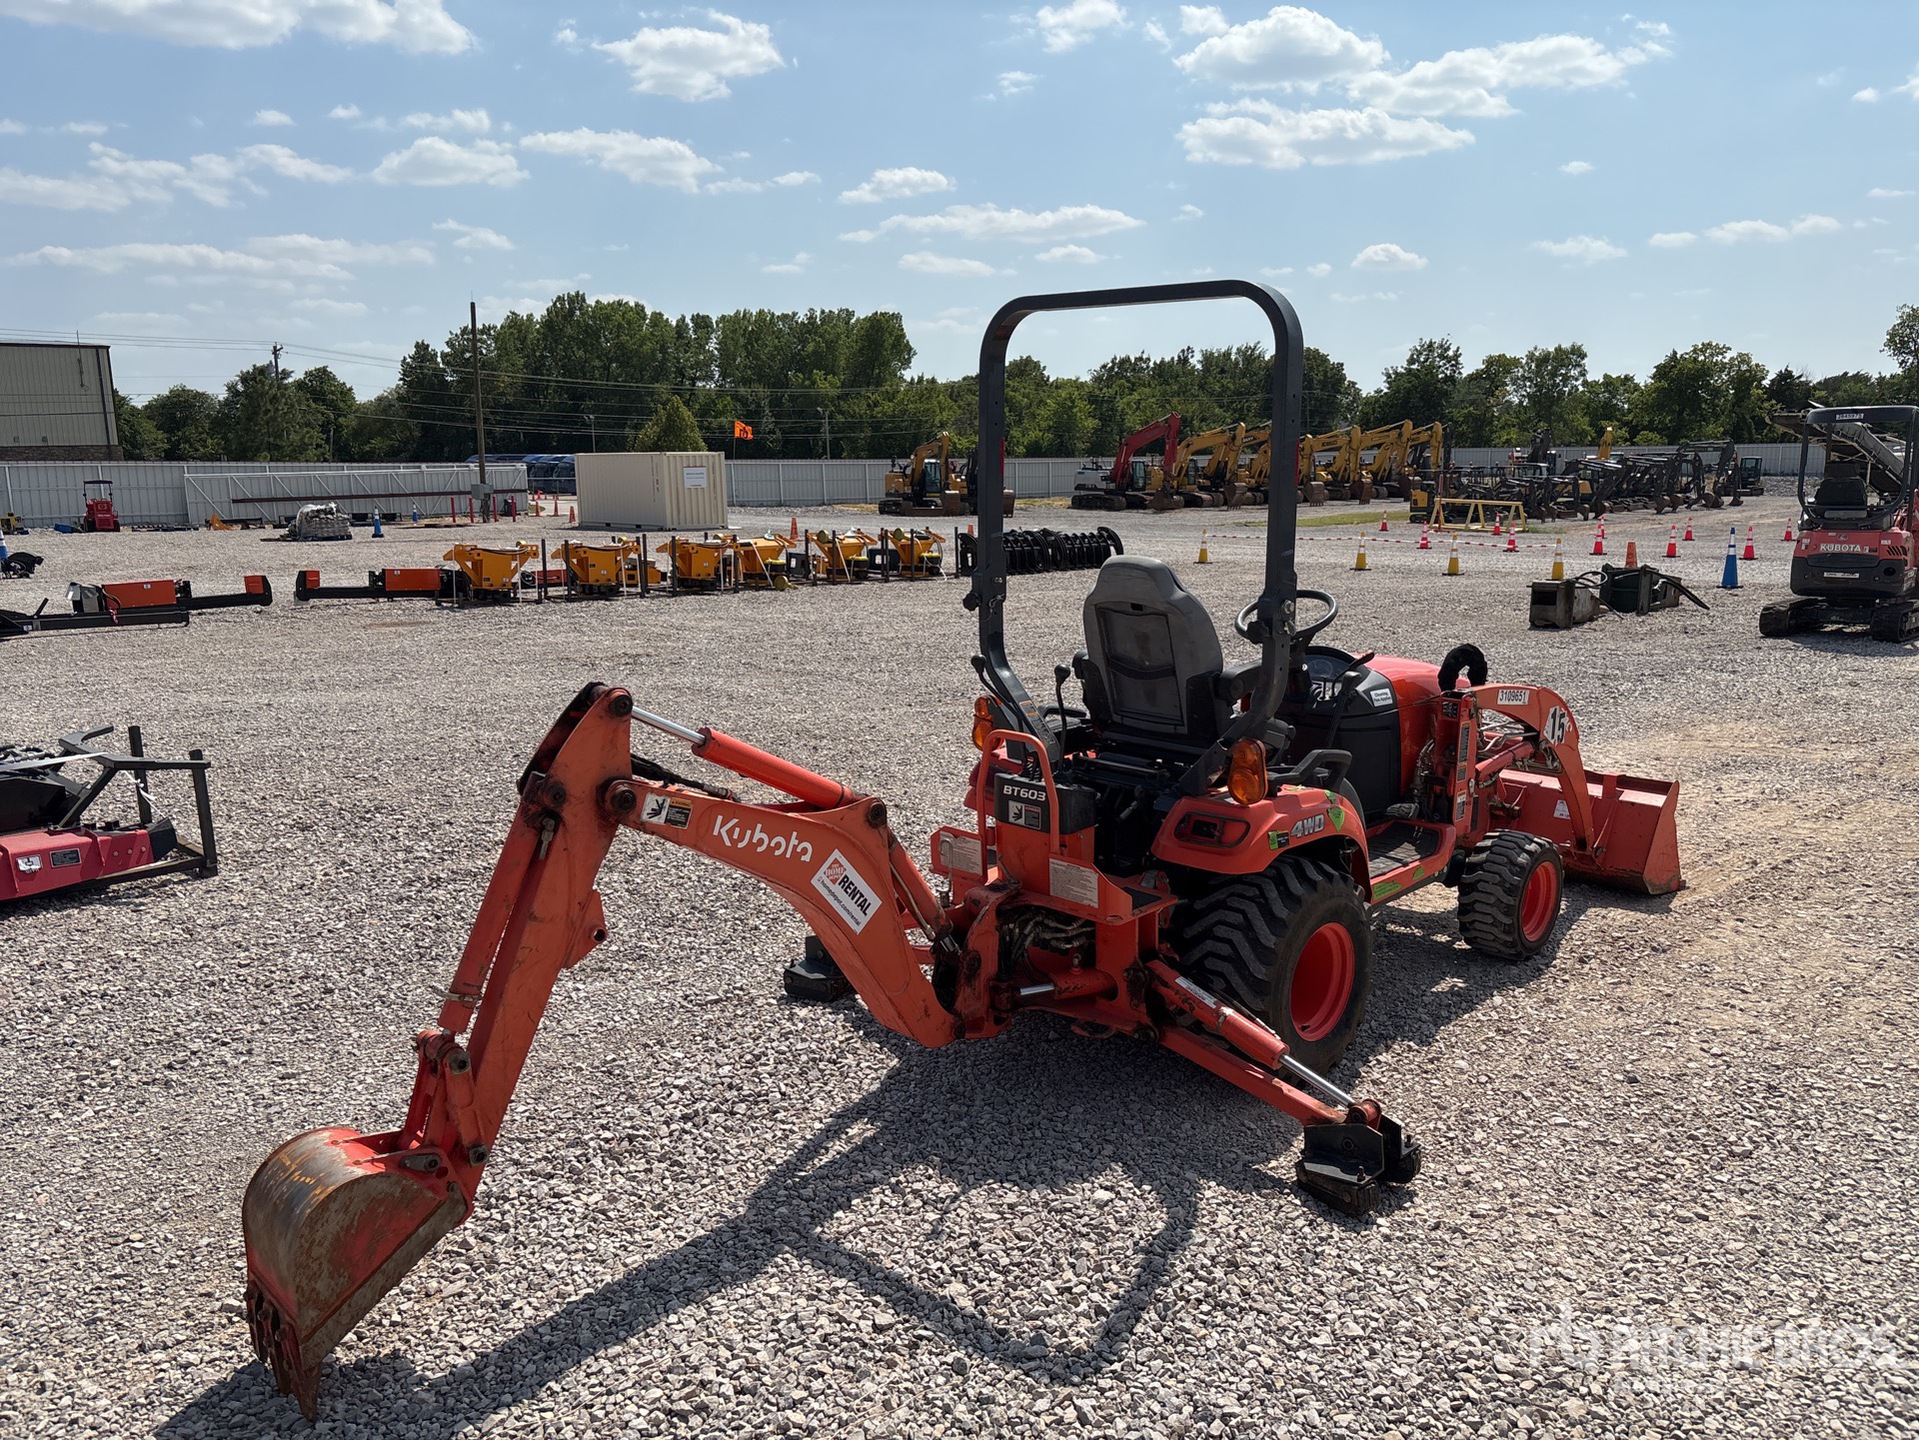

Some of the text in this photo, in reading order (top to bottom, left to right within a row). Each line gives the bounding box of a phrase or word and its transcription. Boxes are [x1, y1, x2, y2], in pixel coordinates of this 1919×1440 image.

[1820, 543, 1862, 552] KUBOTA
[1499, 690, 1526, 701] 3109651
[1003, 785, 1047, 801] BT603
[1290, 814, 1325, 838] 4WD
[713, 815, 813, 862] Kubota
[838, 874, 872, 917] RENTAL
